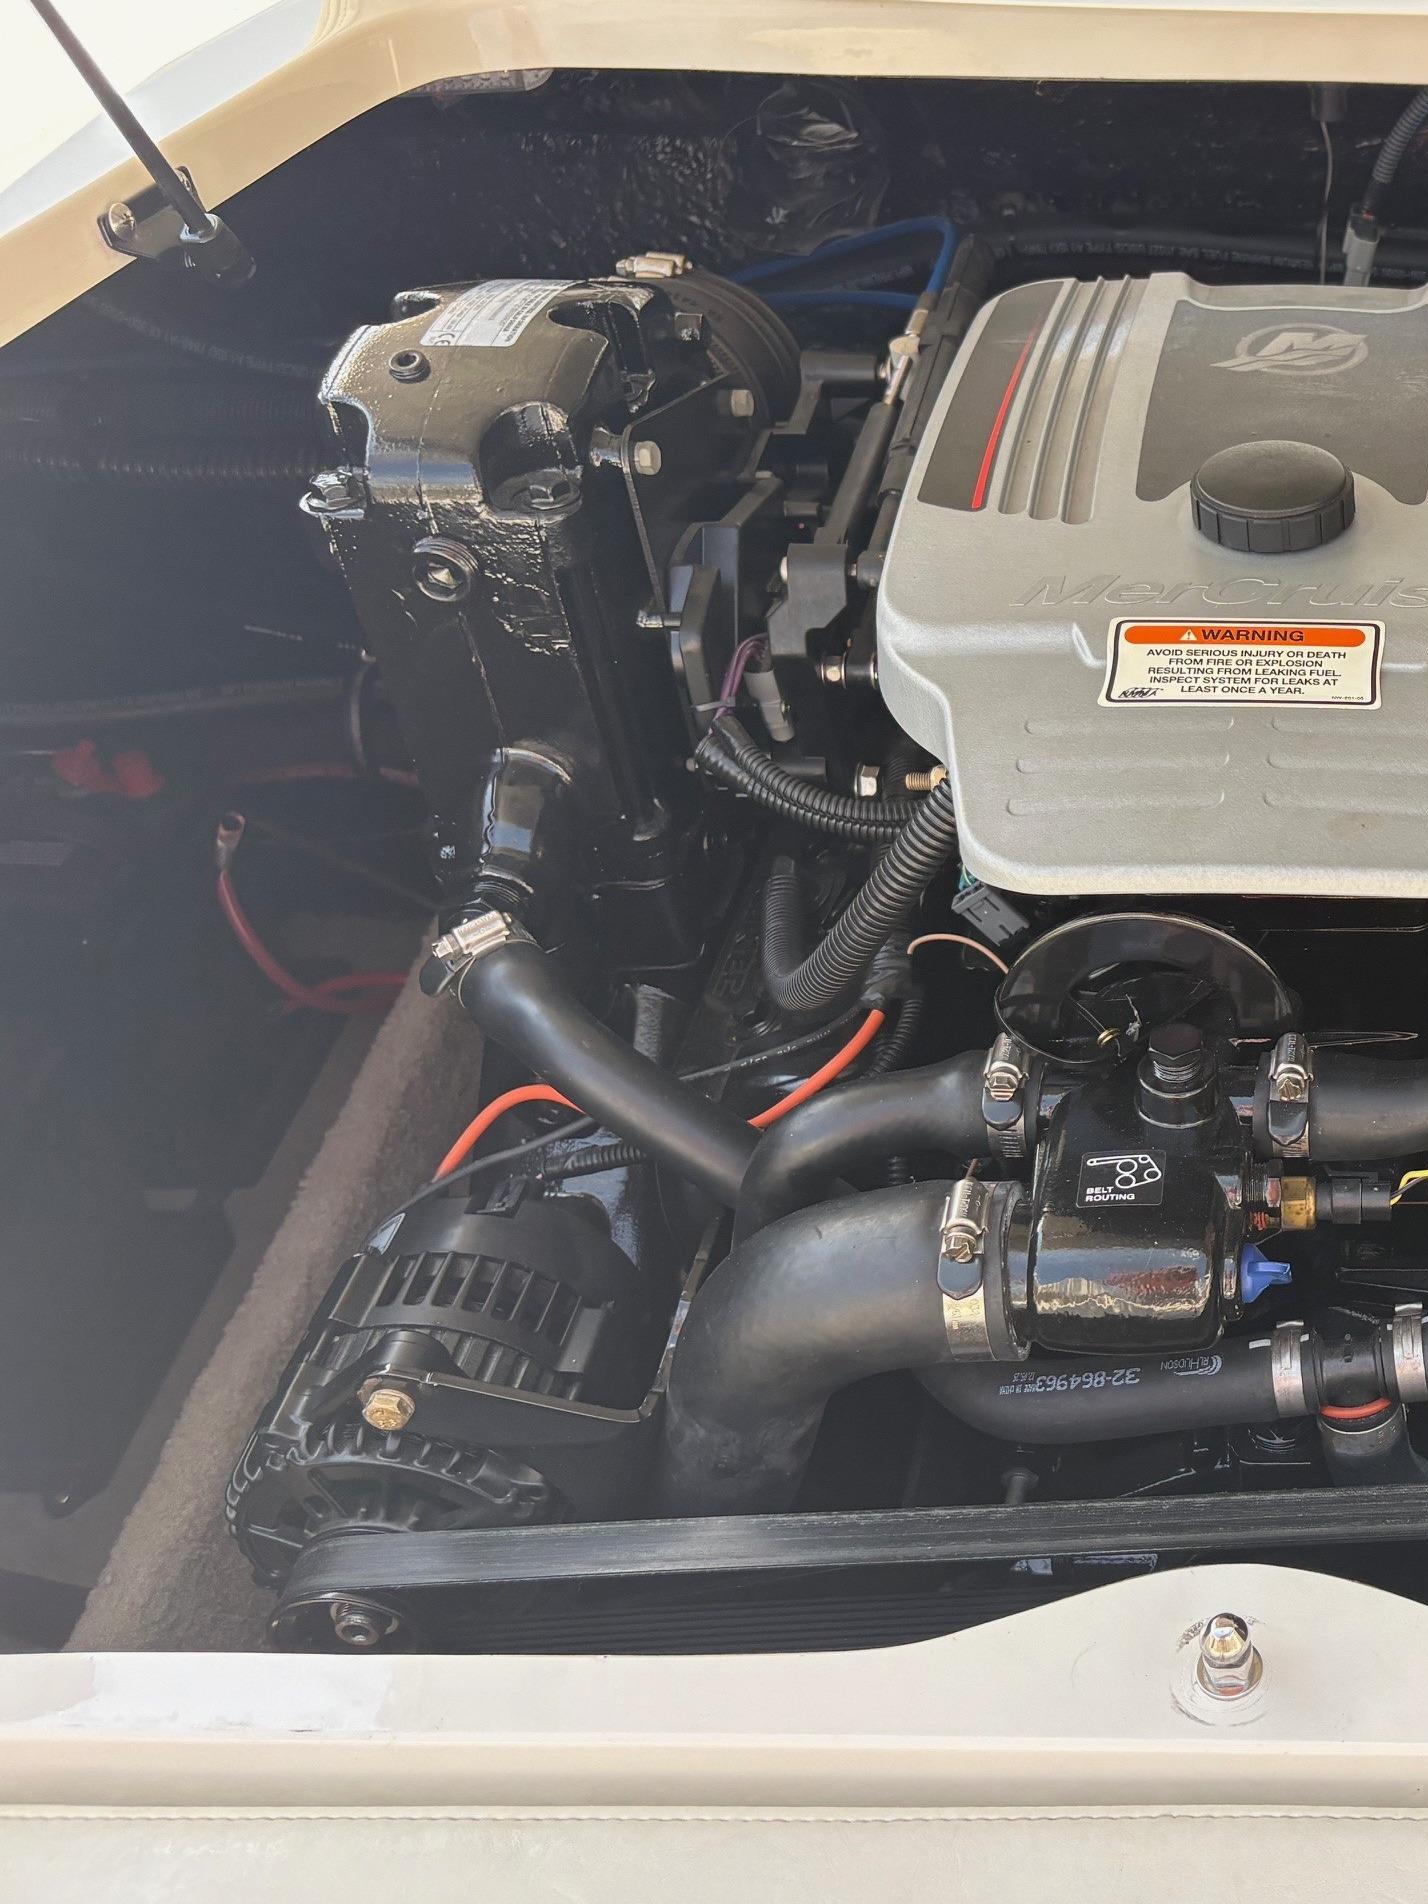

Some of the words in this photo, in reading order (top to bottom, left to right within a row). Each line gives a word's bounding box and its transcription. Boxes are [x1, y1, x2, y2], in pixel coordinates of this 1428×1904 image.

[1202, 629, 1304, 642] WARNING
[1147, 649, 1185, 657] AVOID
[1186, 649, 1238, 657] SERIOUS
[1240, 650, 1284, 658] INJURY
[1307, 651, 1346, 659] DEATH
[1168, 658, 1204, 666] FROM
[1206, 658, 1233, 666] FIRE
[1236, 659, 1253, 667] OR
[1255, 659, 1322, 668] EXPLOSION
[1148, 667, 1214, 675] RESULTING
[1217, 667, 1252, 676] FROM
[1254, 668, 1307, 677] LEAKING
[1309, 669, 1342, 677] FUEL.
[1150, 676, 1201, 684] INSPECT
[1203, 676, 1251, 685] SYSTEM
[1254, 677, 1278, 685] FOR
[1281, 677, 1320, 686] LEAKS
[1322, 678, 1338, 686] AT
[1180, 685, 1219, 693] LEAST
[1221, 686, 1256, 694] ONCE
[1258, 686, 1267, 694] A
[1270, 686, 1305, 695] YEAR.
[1086, 1186, 1114, 1195] BELT
[1085, 1193, 1135, 1202] ROUTING
[1036, 1367, 1141, 1392] 32-864963
